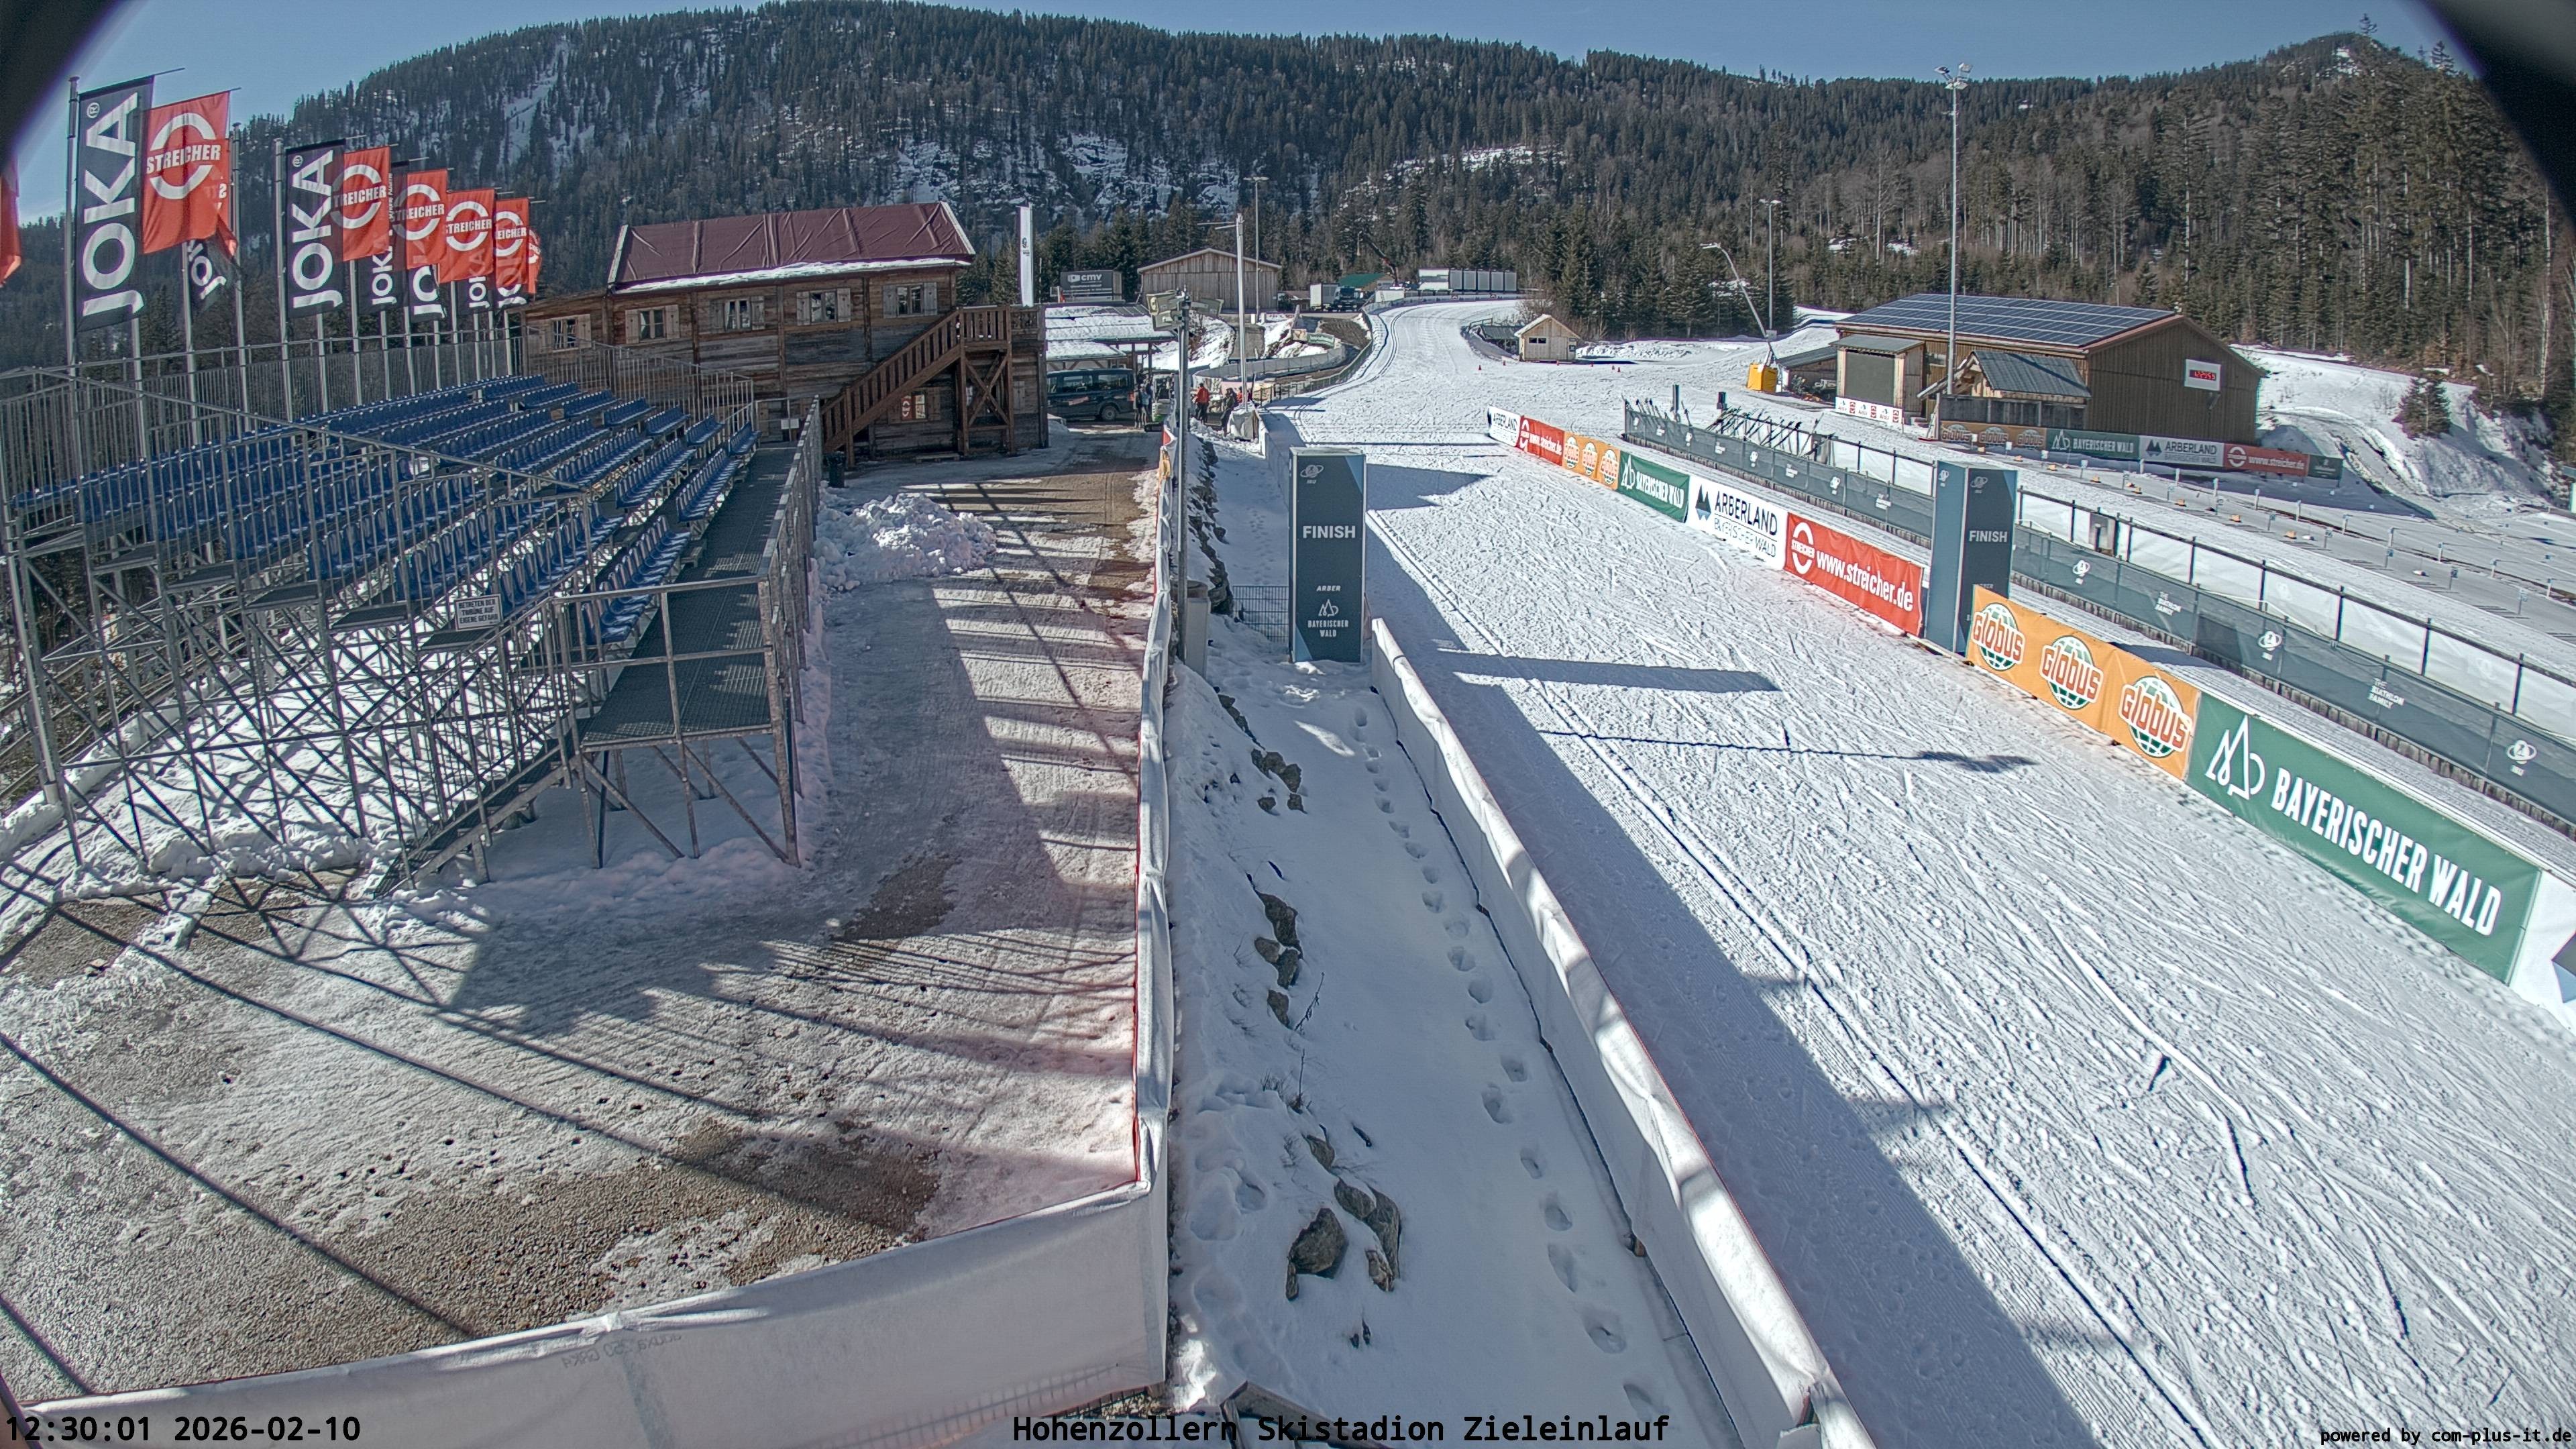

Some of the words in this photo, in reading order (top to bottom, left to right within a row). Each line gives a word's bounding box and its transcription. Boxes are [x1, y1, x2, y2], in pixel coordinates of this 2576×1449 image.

[146, 144, 221, 174] STREICHER
[83, 92, 144, 316] JOKA
[292, 150, 343, 309] JOKA
[2072, 438, 2116, 451] BAYERISCHER
[2116, 441, 2134, 453] WALD
[2165, 440, 2217, 455] ARBERLAND
[2249, 454, 2305, 470] www.streicher.de
[1635, 471, 1668, 502] BAYERISCHER
[1668, 485, 1684, 509] WALD
[1715, 490, 1778, 536] ARBERLAND
[1303, 525, 1356, 539] FINISH
[1969, 530, 2008, 543] FINISH
[1755, 536, 1776, 558] WALD
[1817, 550, 1913, 611] www.streicher.de
[1307, 619, 1349, 628] BAYERISCHER
[1320, 629, 1337, 637] WALD
[2271, 767, 2428, 894] BAYERISCHER
[2428, 853, 2502, 936] WALD
